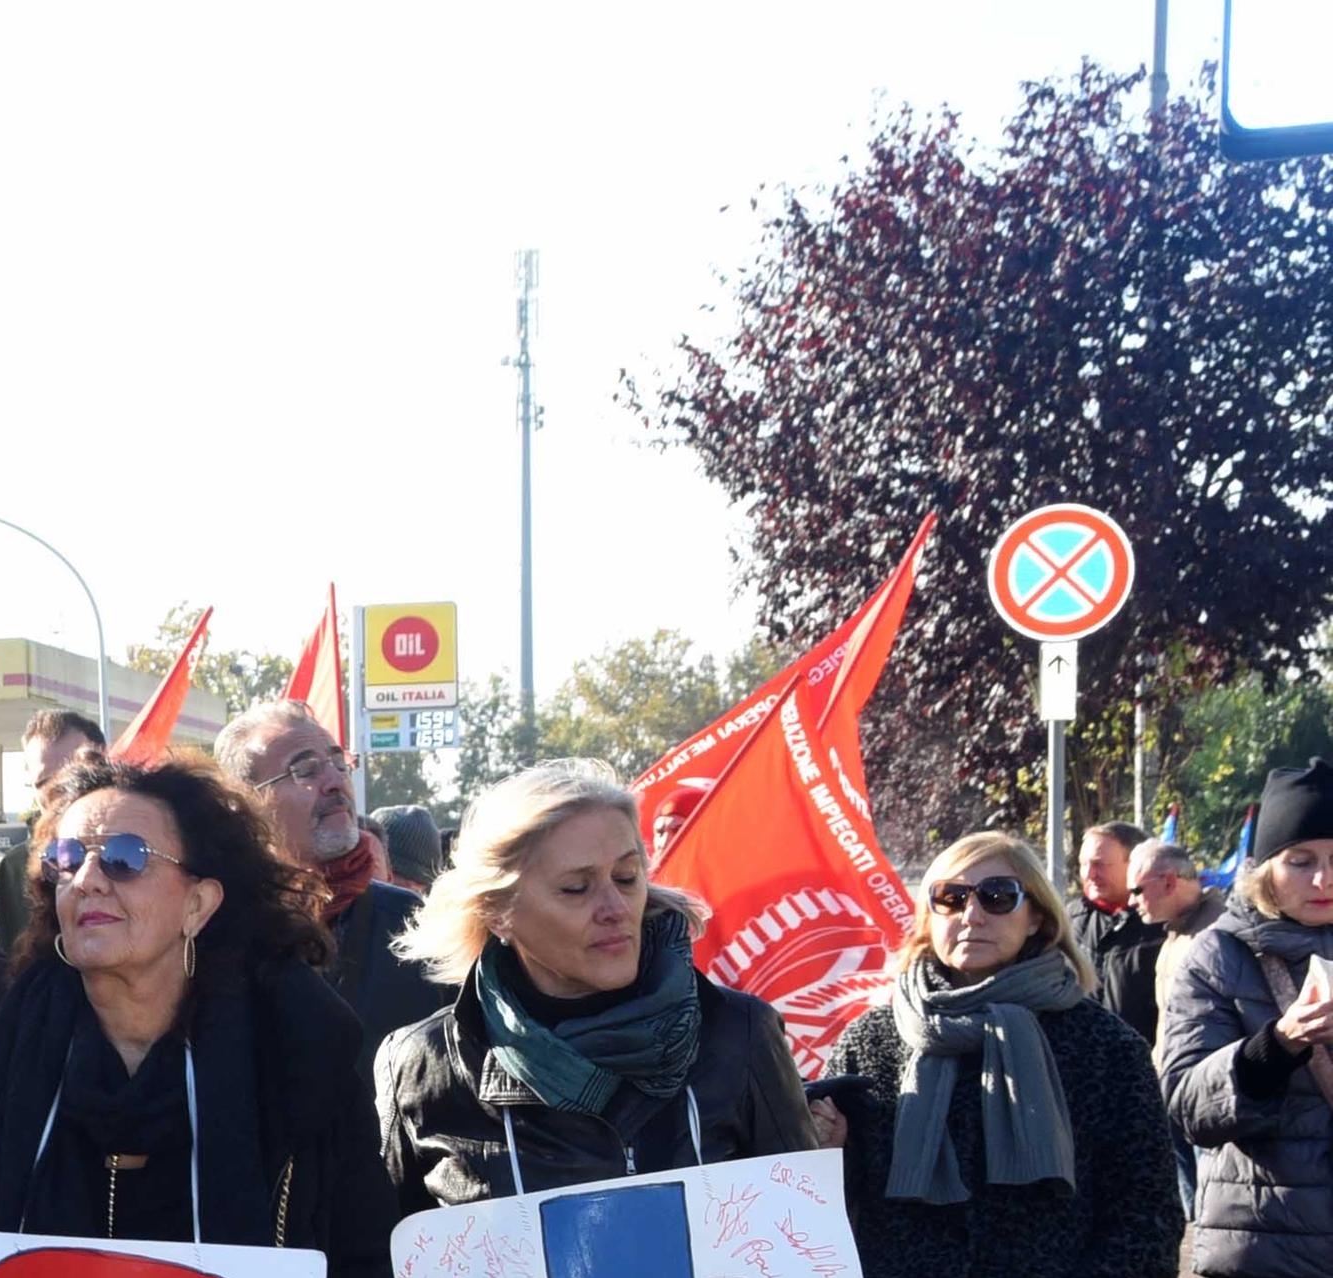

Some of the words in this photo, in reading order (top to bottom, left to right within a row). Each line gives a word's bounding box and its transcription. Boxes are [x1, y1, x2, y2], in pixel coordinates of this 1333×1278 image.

[375, 690, 399, 703] OIL
[401, 689, 446, 702] ITALIA
[808, 785, 877, 876] IMPIEGATI
